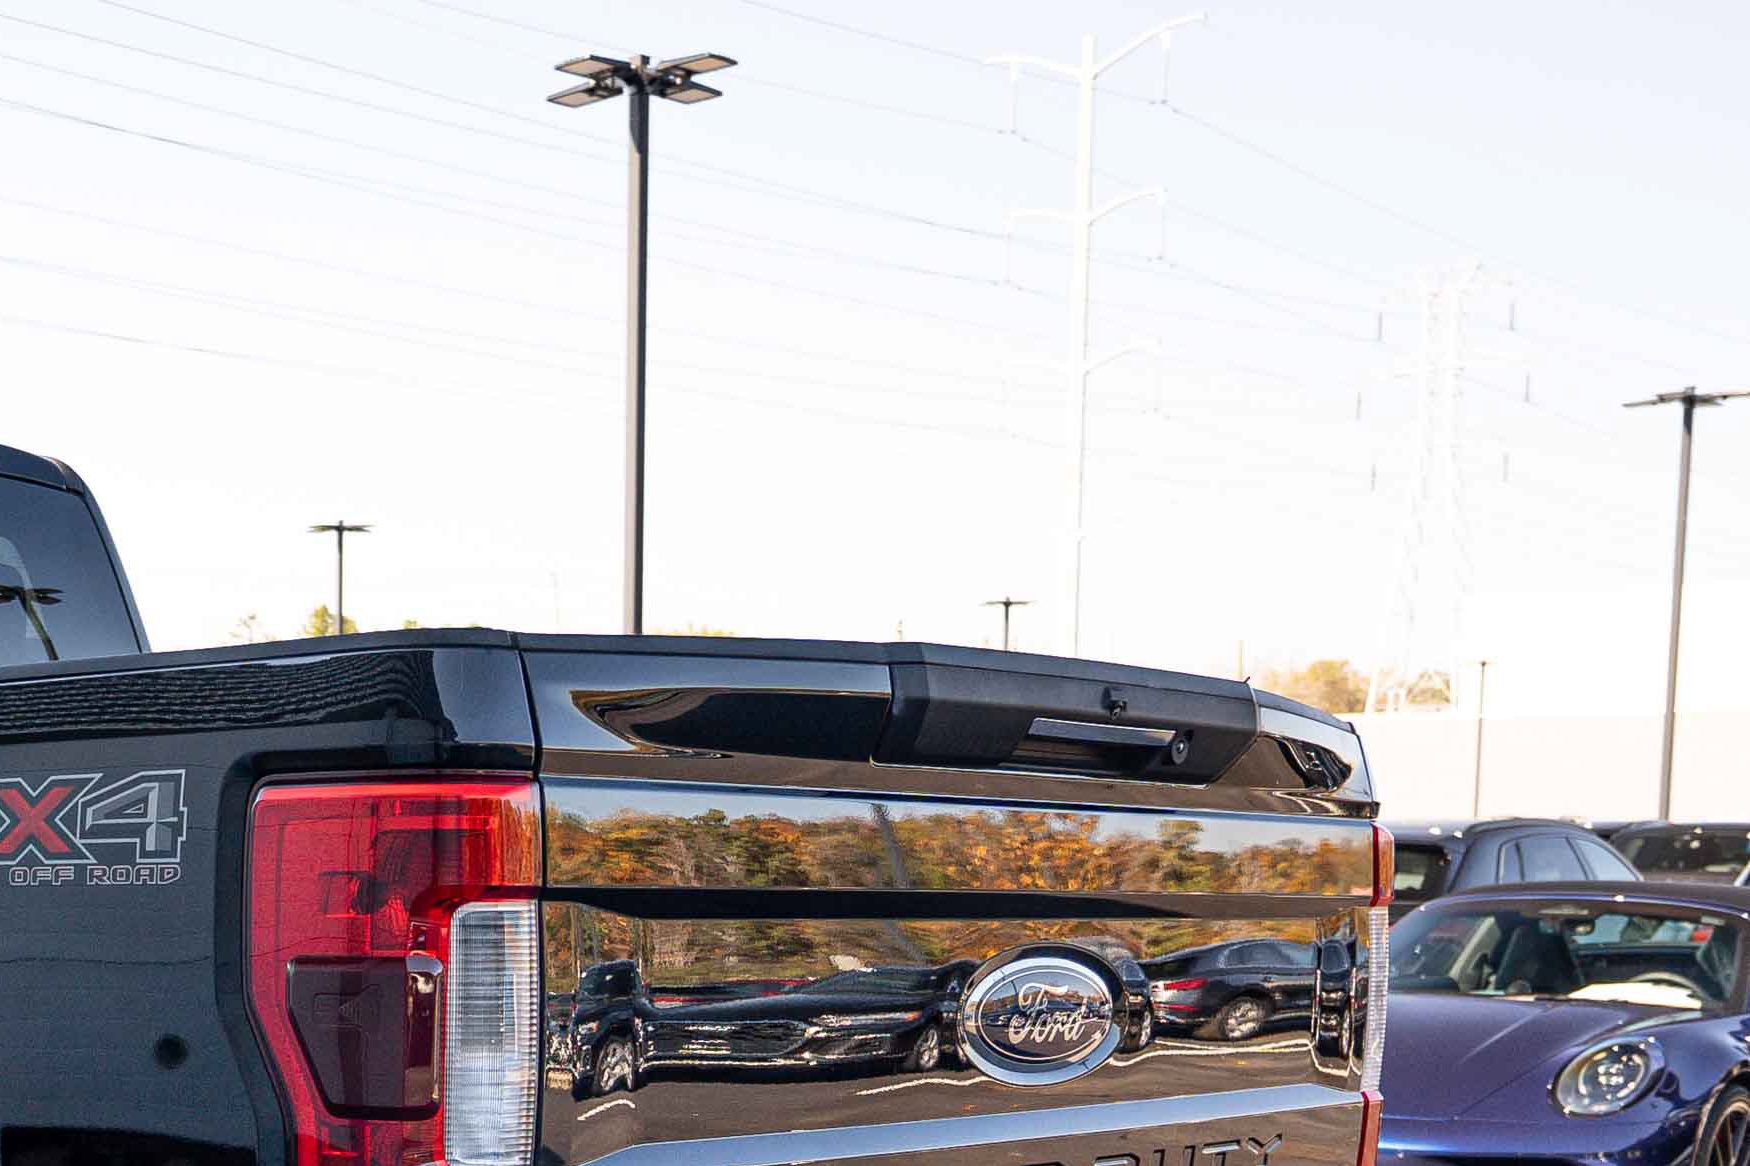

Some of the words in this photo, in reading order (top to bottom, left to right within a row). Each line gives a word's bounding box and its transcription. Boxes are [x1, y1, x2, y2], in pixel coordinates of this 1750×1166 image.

[9, 866, 74, 886] OFF
[87, 865, 181, 885] ROAD
[1006, 983, 1098, 1045] Ford
